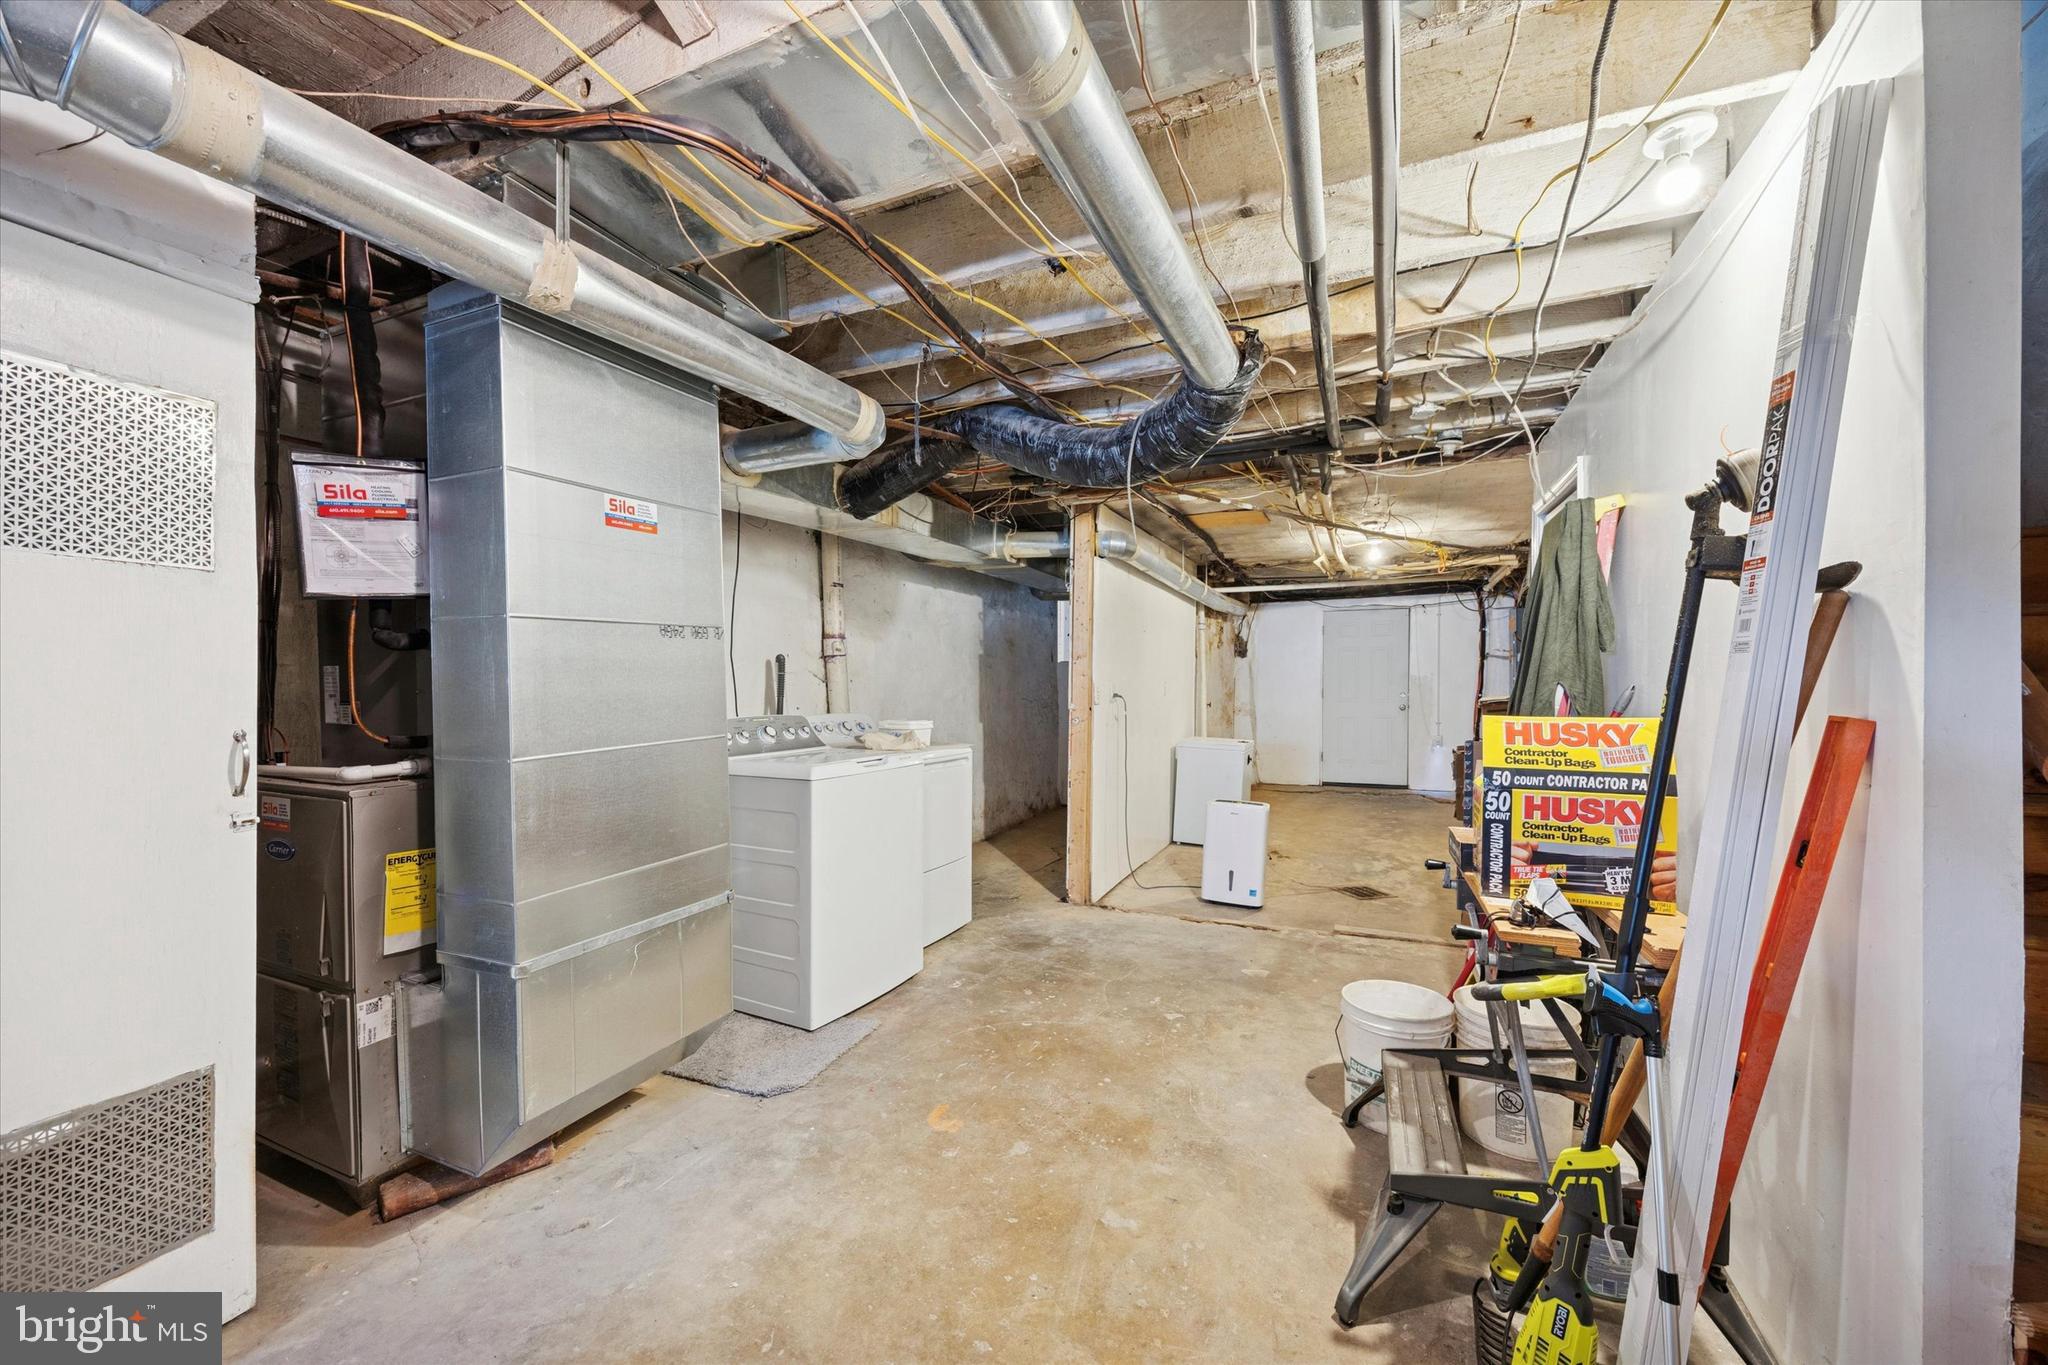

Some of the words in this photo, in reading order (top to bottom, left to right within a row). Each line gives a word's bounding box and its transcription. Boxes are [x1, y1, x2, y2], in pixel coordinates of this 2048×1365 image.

[1756, 406, 1785, 512] DOORPAK
[323, 484, 368, 500] Sila
[609, 498, 635, 515] Sila
[1504, 722, 1640, 748] HUSKY
[1504, 748, 1568, 758] Contractor
[1564, 758, 1596, 769] Bags
[1492, 770, 1511, 786] 50
[1514, 776, 1544, 786] COUNT
[1546, 774, 1628, 790] CONTRACTOR
[1631, 778, 1648, 791] PA
[263, 802, 278, 816] Sila
[1485, 790, 1511, 812] 50
[1485, 811, 1510, 820] COUNT
[1523, 794, 1645, 826] HUSKY
[1522, 821, 1584, 833] Contractor
[1489, 823, 1504, 872] CONTRACTOR
[1579, 834, 1611, 845] Bags
[268, 844, 290, 854] Carrier
[1488, 873, 1503, 894] PACK
[1610, 876, 1617, 885] 3
[1620, 876, 1631, 884] M
[1553, 1306, 1568, 1337] RYOBI
